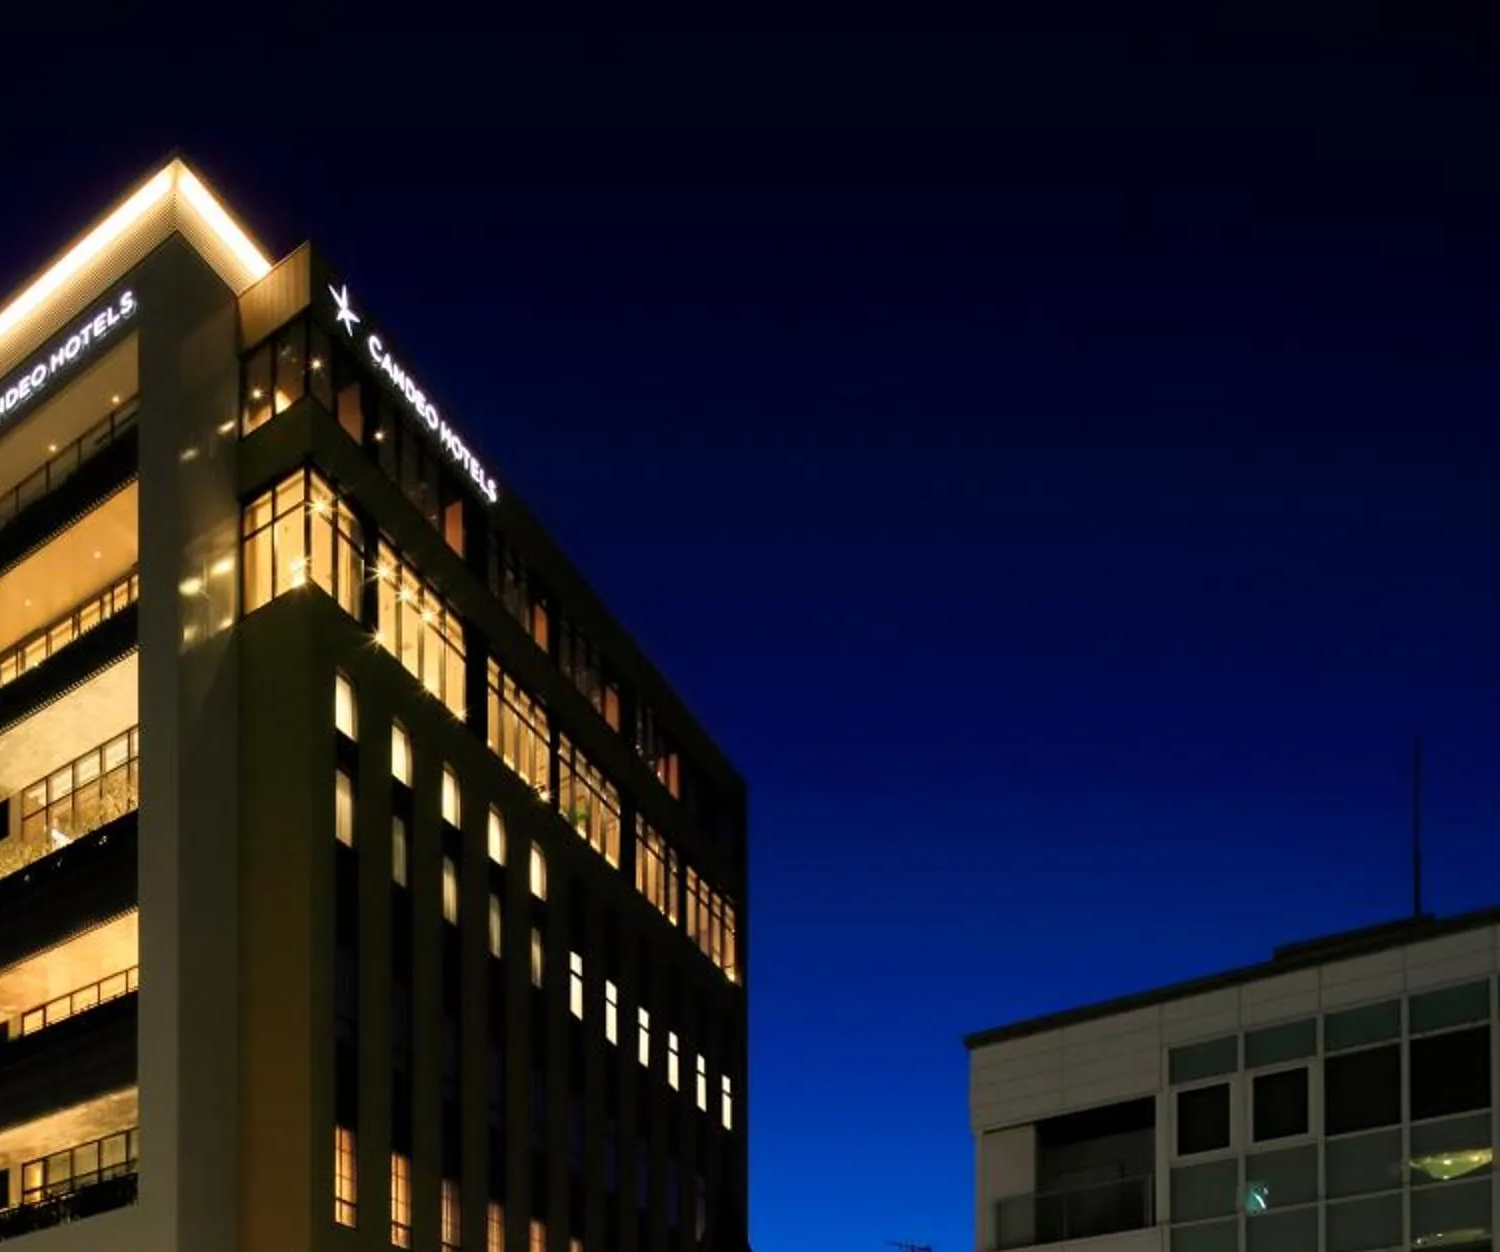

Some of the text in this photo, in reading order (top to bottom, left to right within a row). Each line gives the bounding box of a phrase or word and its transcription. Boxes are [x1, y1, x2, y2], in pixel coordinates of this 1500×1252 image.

[49, 290, 135, 374] HOTELS
[368, 334, 498, 503] CANDEO HOTELS
